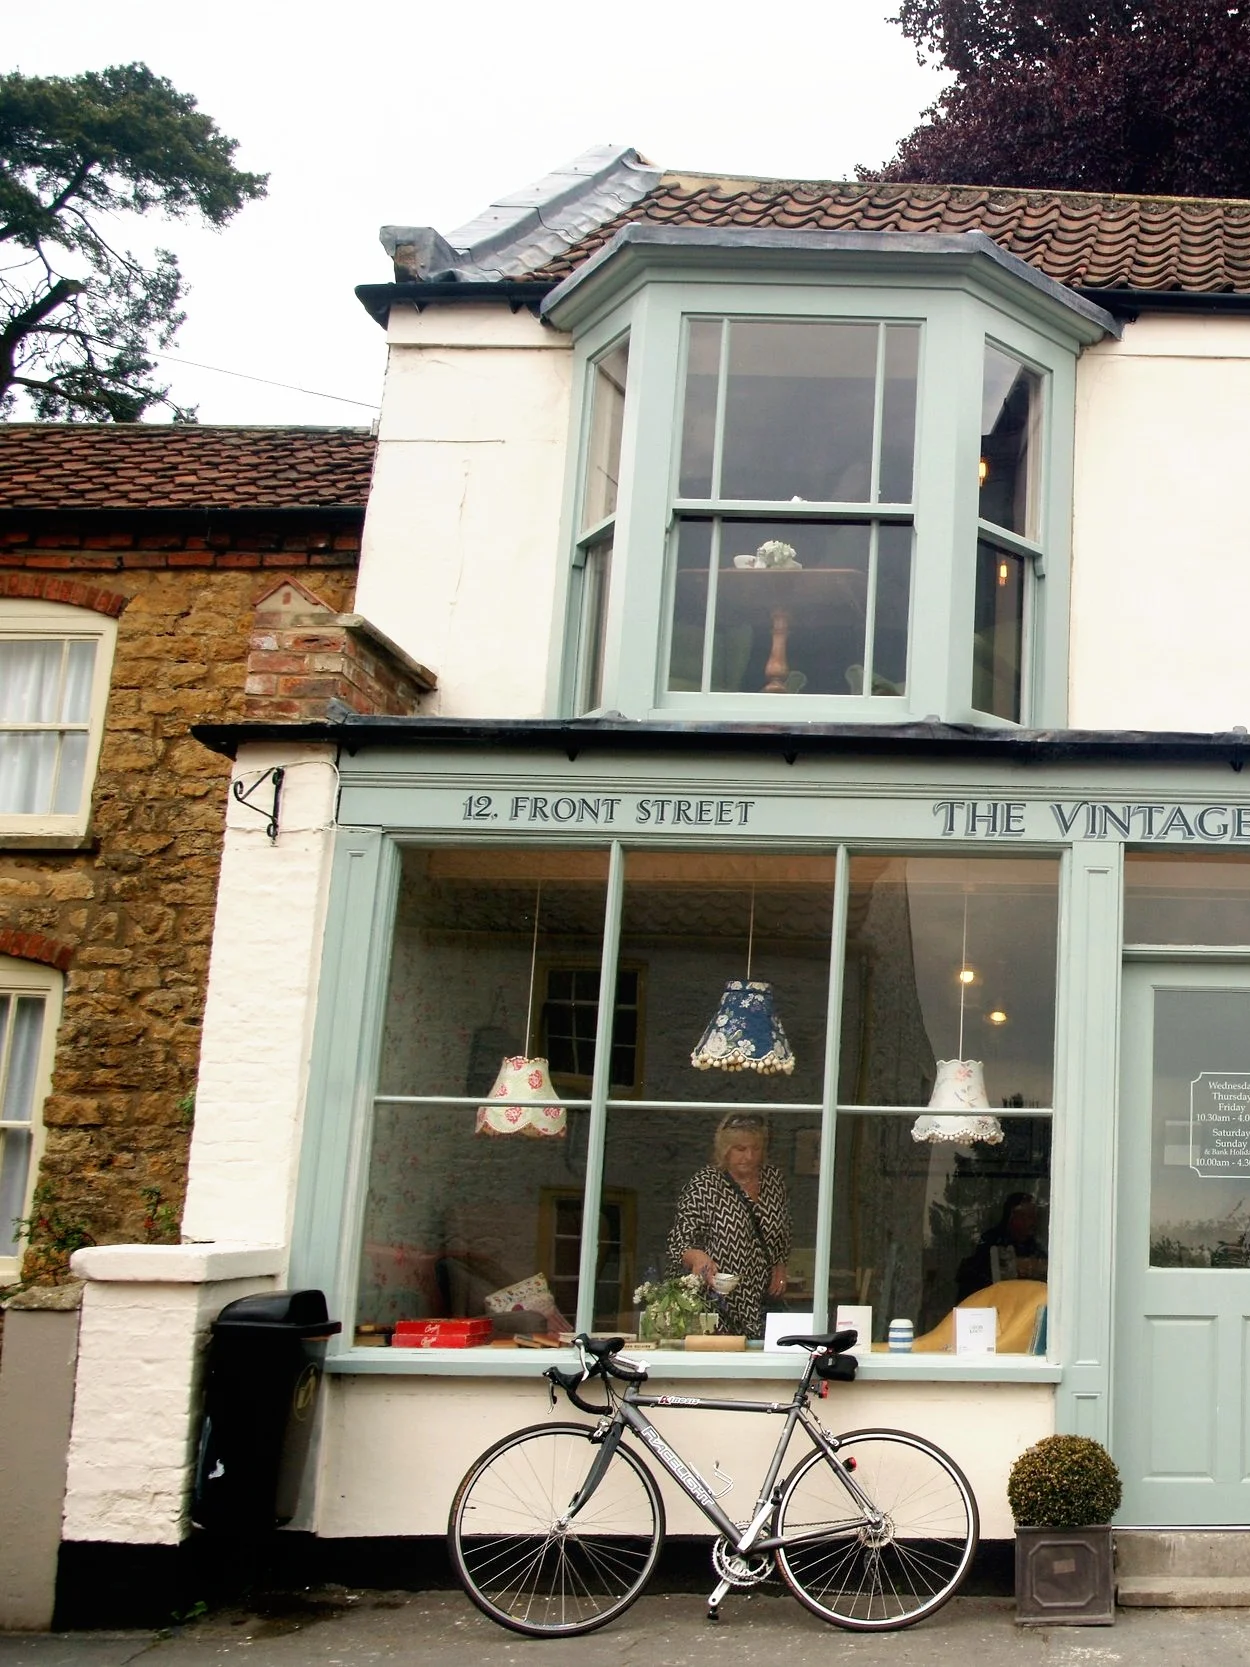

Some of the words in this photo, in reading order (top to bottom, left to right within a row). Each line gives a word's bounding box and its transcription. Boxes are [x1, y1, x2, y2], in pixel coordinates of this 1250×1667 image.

[463, 795, 498, 820] 12.
[508, 797, 621, 823] FRONT
[635, 799, 755, 826] STREET
[933, 801, 1026, 836] THE
[1218, 1103, 1246, 1113] Friday
[1196, 1113, 1230, 1122] 10.30am
[1212, 1128, 1250, 1139] Saturday
[1215, 1139, 1248, 1150] Sunday
[1195, 1158, 1230, 1167] 10.00am
[641, 1425, 715, 1506] RACELIGHT
